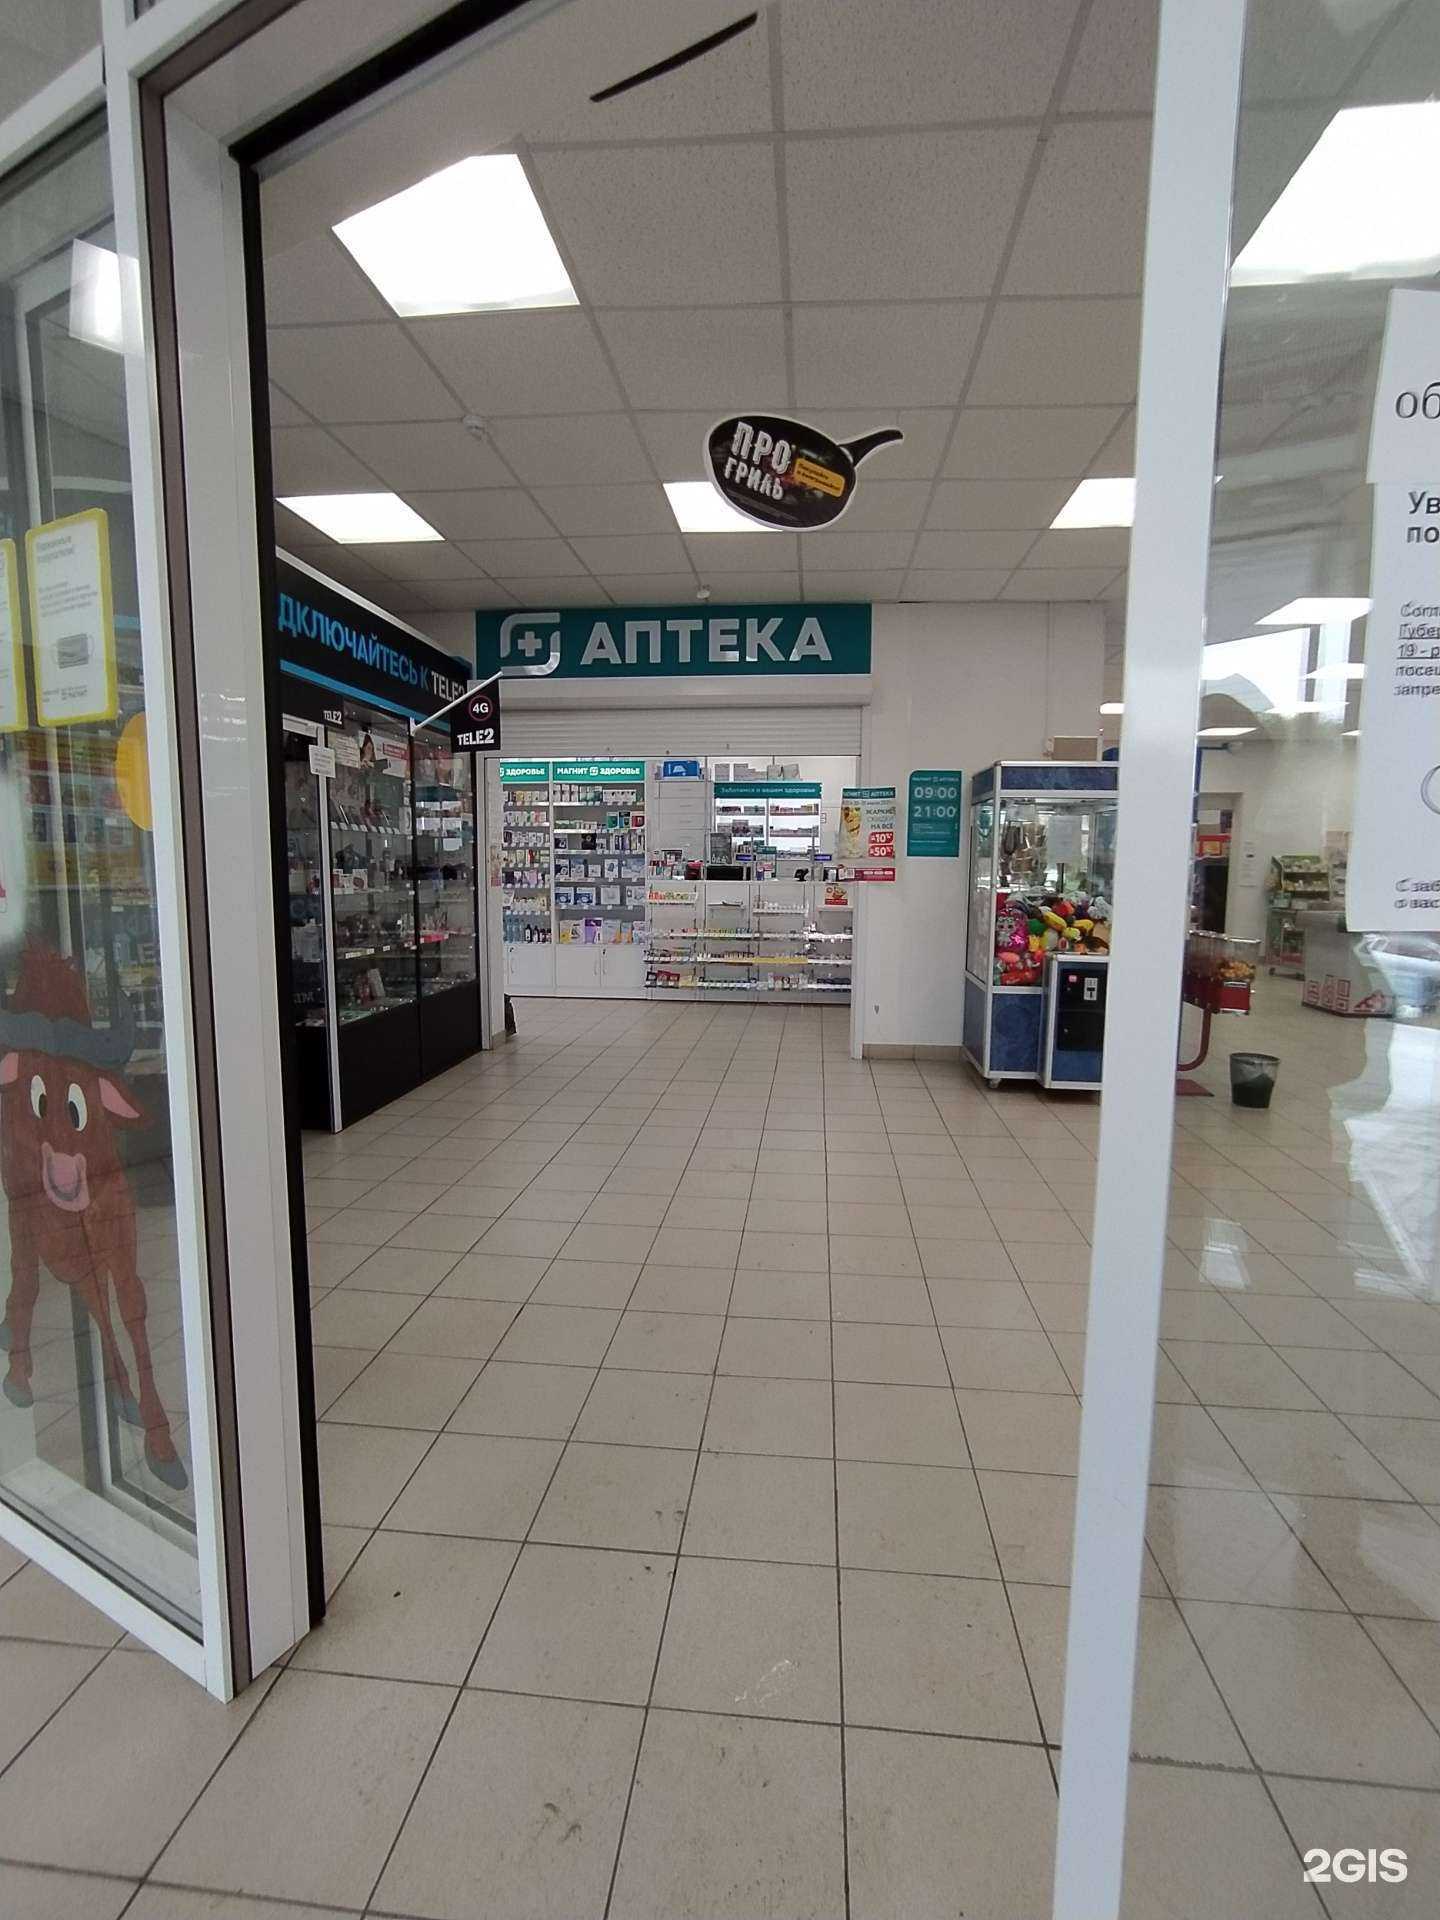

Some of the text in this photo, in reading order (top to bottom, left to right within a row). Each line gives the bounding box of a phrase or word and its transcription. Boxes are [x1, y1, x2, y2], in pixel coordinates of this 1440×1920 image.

[731, 421, 791, 475] ПРО
[724, 457, 784, 500] ГРИЛЬ
[1407, 526, 1440, 543] по
[580, 617, 832, 665] АПТЕКА
[472, 703, 488, 714] 4G
[323, 709, 342, 725] TELE2
[457, 727, 494, 746] TELE2
[505, 768, 545, 776] ЗДОРОВЬЕ
[557, 767, 640, 776] МАГНИТ ЗДОРОВЬЕ
[914, 786, 957, 799] 09:00
[913, 806, 956, 818] 21:00
